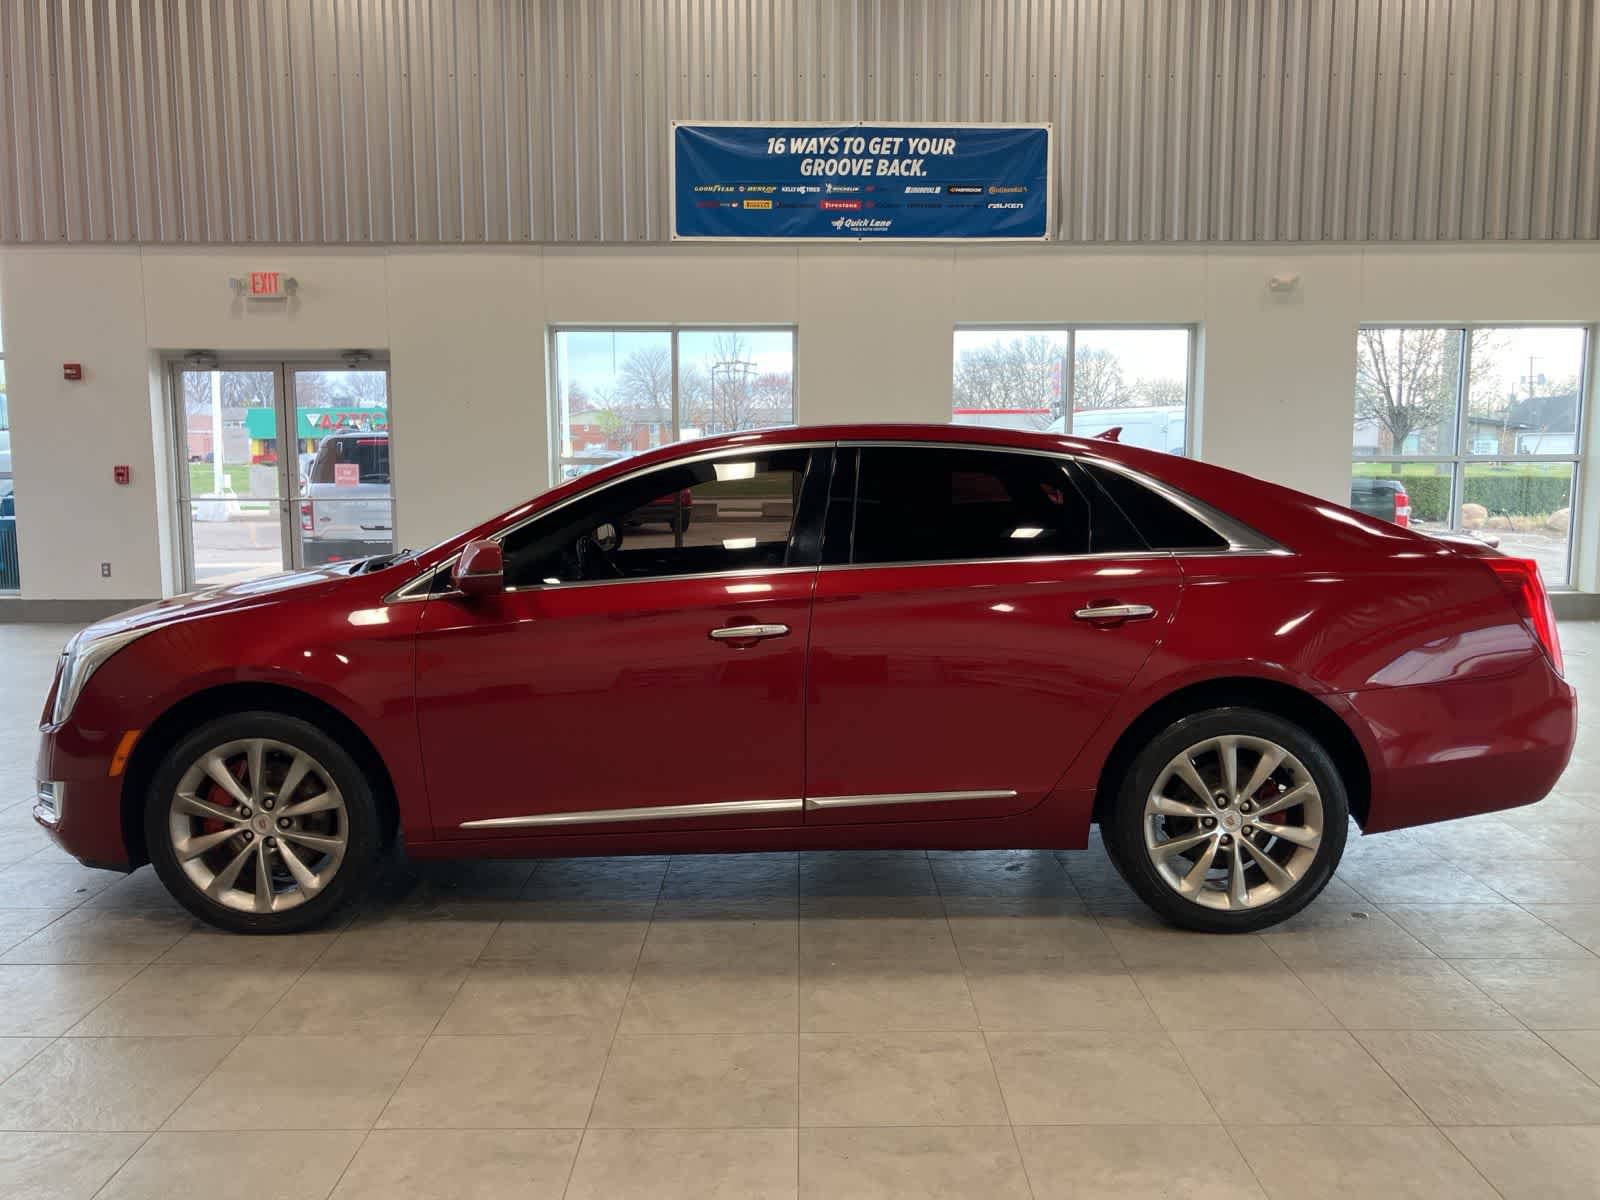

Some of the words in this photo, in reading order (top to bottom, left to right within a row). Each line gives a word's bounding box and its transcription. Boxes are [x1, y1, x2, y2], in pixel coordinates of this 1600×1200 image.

[767, 137, 785, 154] 16
[790, 137, 839, 154] WAYS
[843, 137, 865, 154] TO
[868, 137, 903, 155] GET
[908, 138, 956, 155] YOUR
[800, 158, 874, 176] GROOVE
[876, 158, 928, 176] BACK.
[844, 218, 868, 227] Quick
[869, 218, 892, 227] Lane
[252, 271, 279, 295] EXIT
